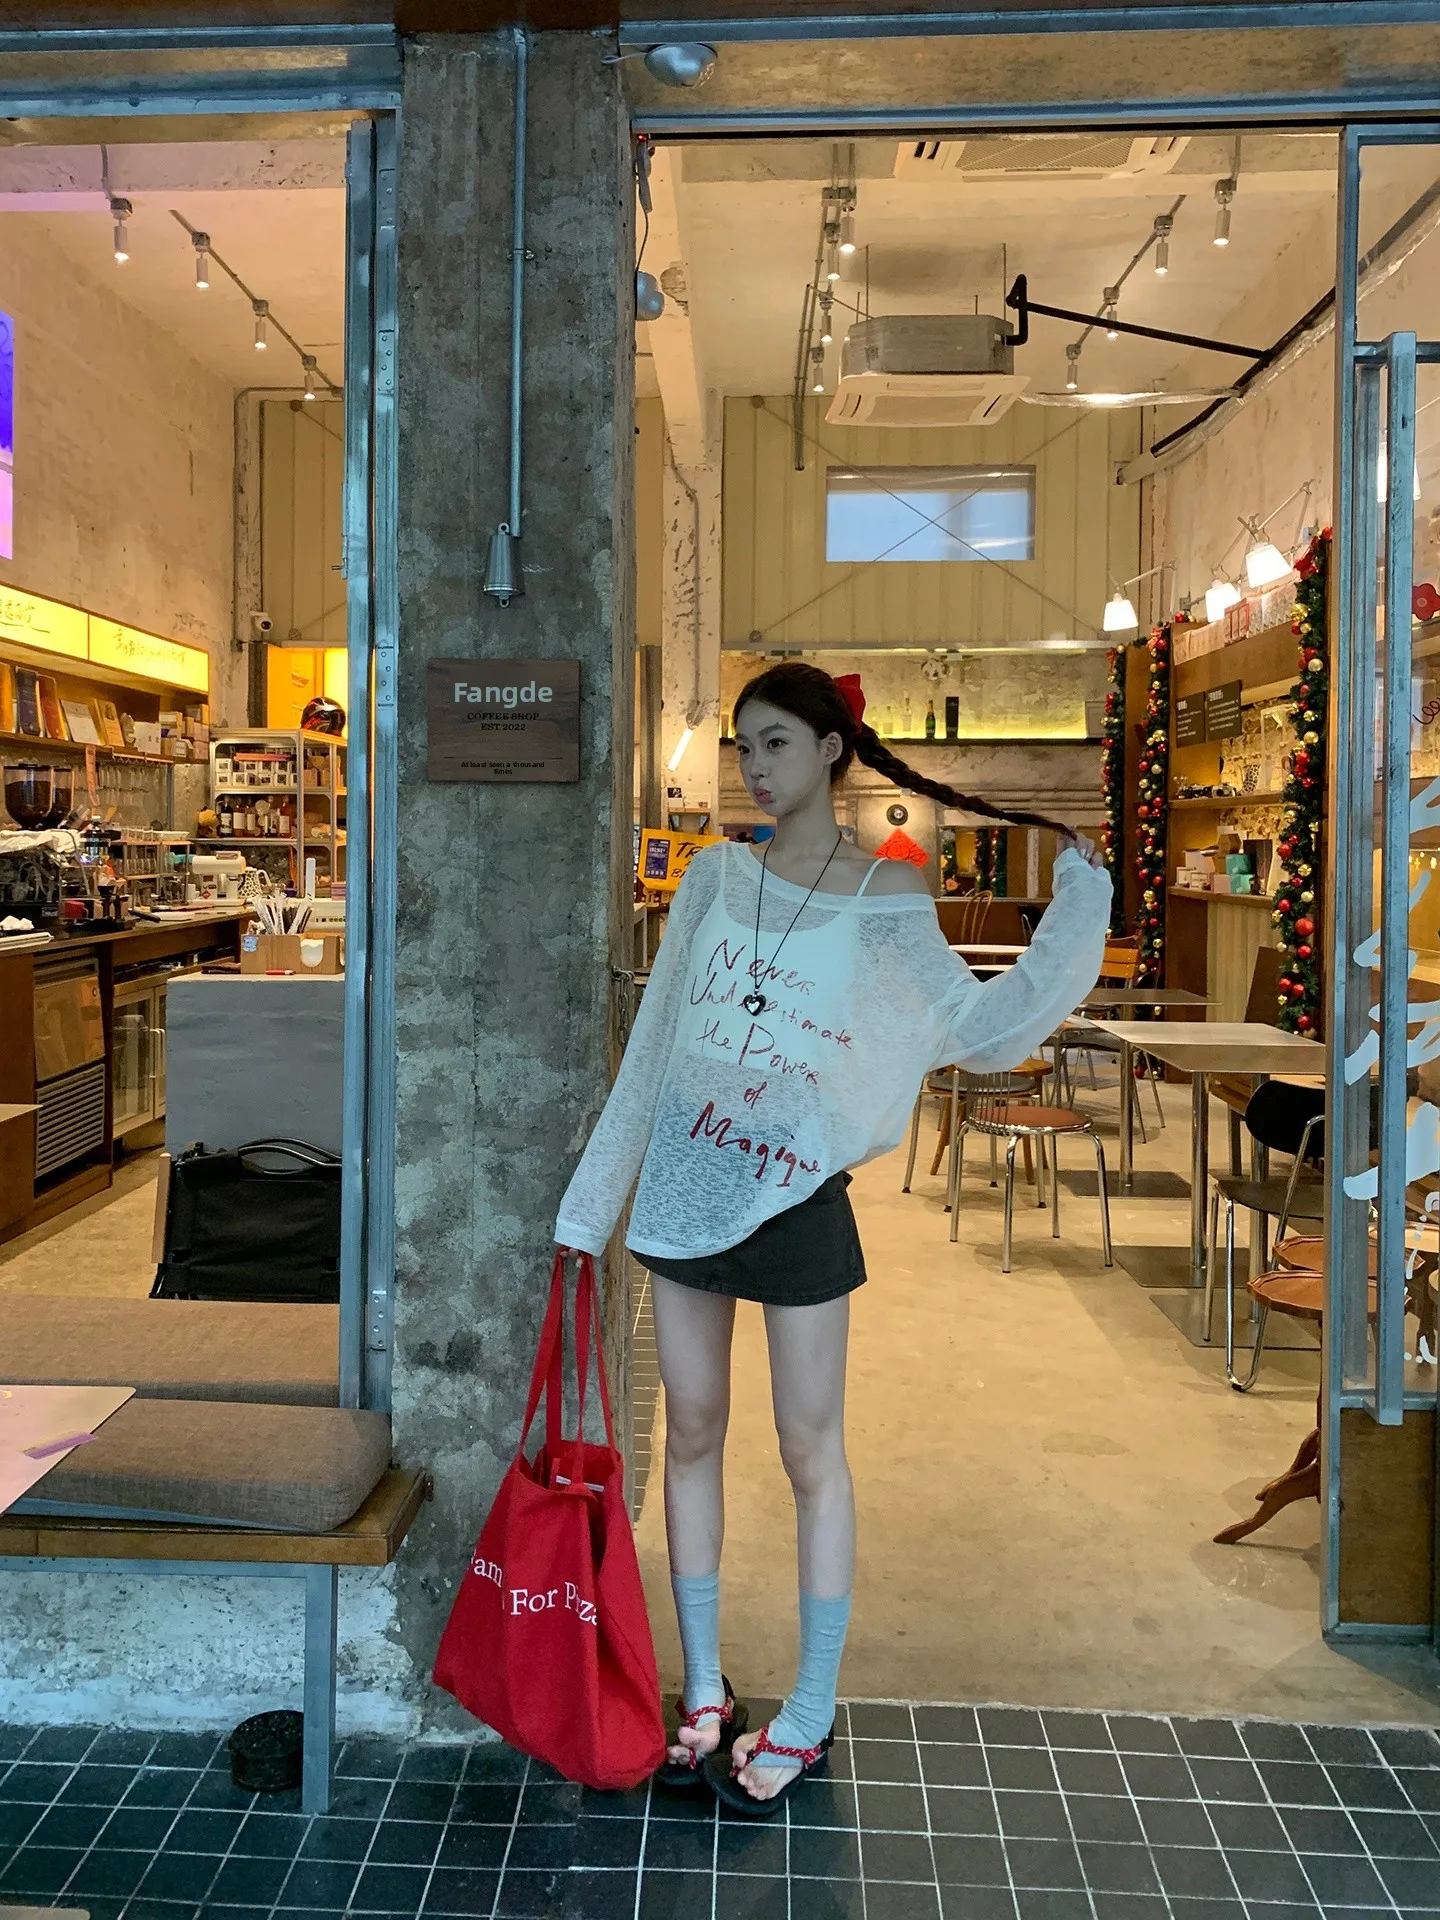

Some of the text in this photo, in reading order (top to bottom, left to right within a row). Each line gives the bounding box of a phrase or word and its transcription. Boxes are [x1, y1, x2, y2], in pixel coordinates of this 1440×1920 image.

[454, 681, 552, 708] Fangde
[467, 712, 539, 721] COFFEE SHOP
[481, 723, 526, 731] EST 2022
[676, 842, 704, 858] TR
[690, 971, 853, 1050] Undestimate
[696, 1018, 732, 1052] the
[743, 1081, 767, 1110] of
[690, 1100, 821, 1187] Magique
[509, 1588, 558, 1615] For
